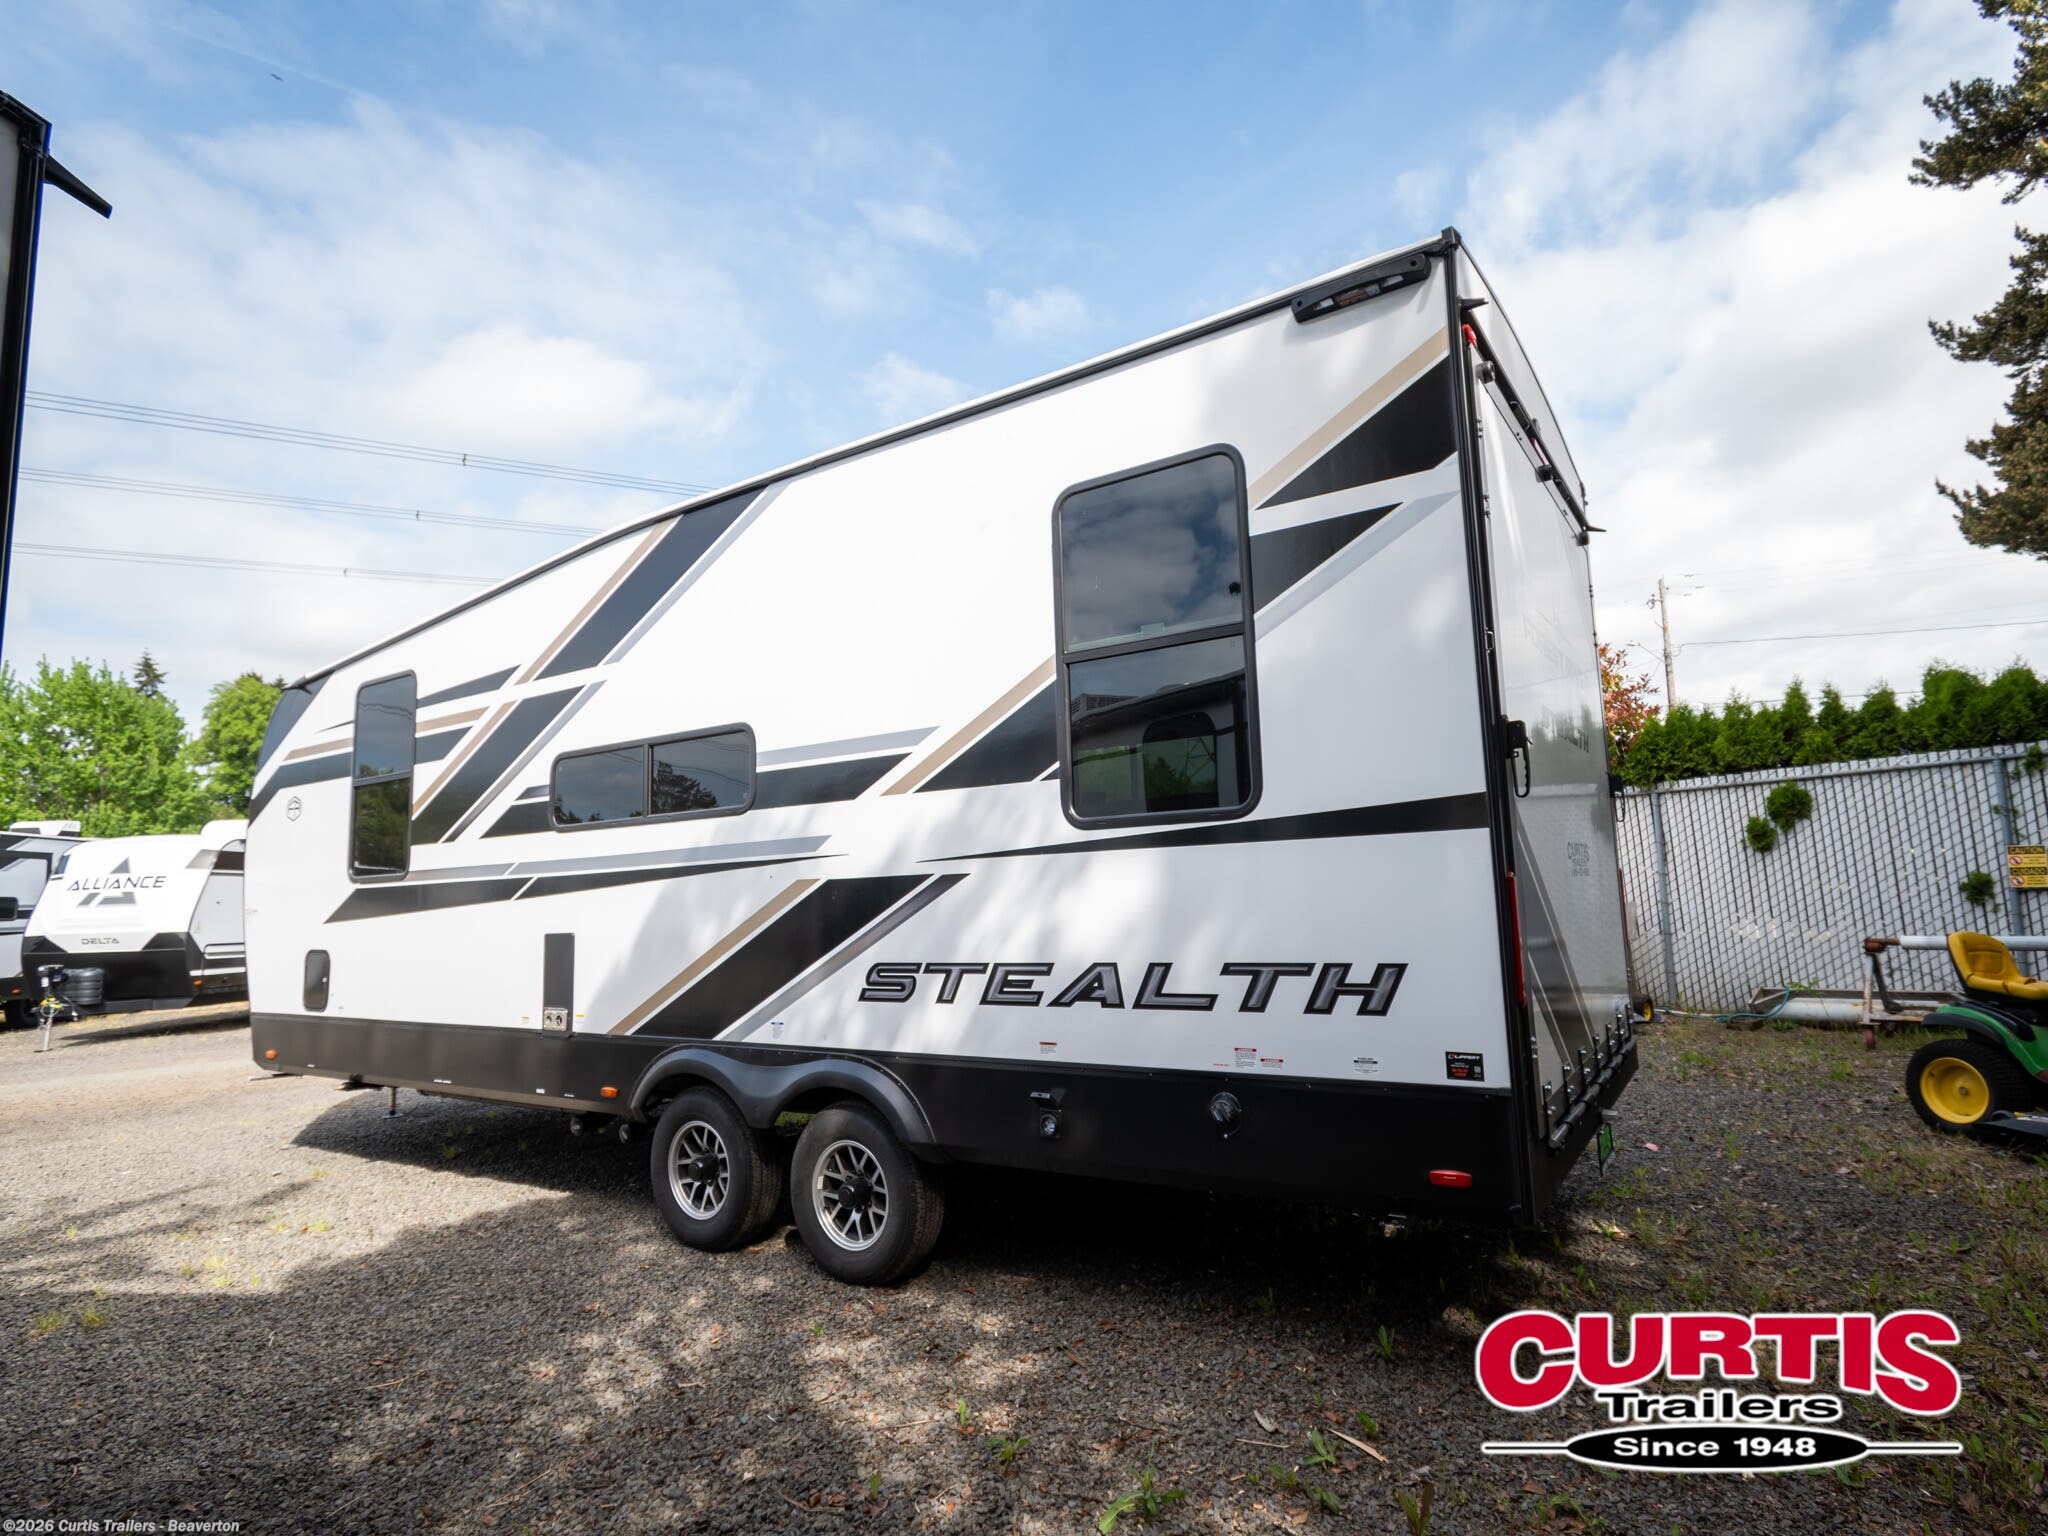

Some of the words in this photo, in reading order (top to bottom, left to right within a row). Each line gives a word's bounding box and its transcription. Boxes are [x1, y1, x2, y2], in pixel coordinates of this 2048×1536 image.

[2010, 846, 2045, 854] CAUTION
[67, 876, 167, 891] ALLIANCE
[80, 937, 120, 945] DELTA
[858, 962, 1409, 1017] STEALTH
